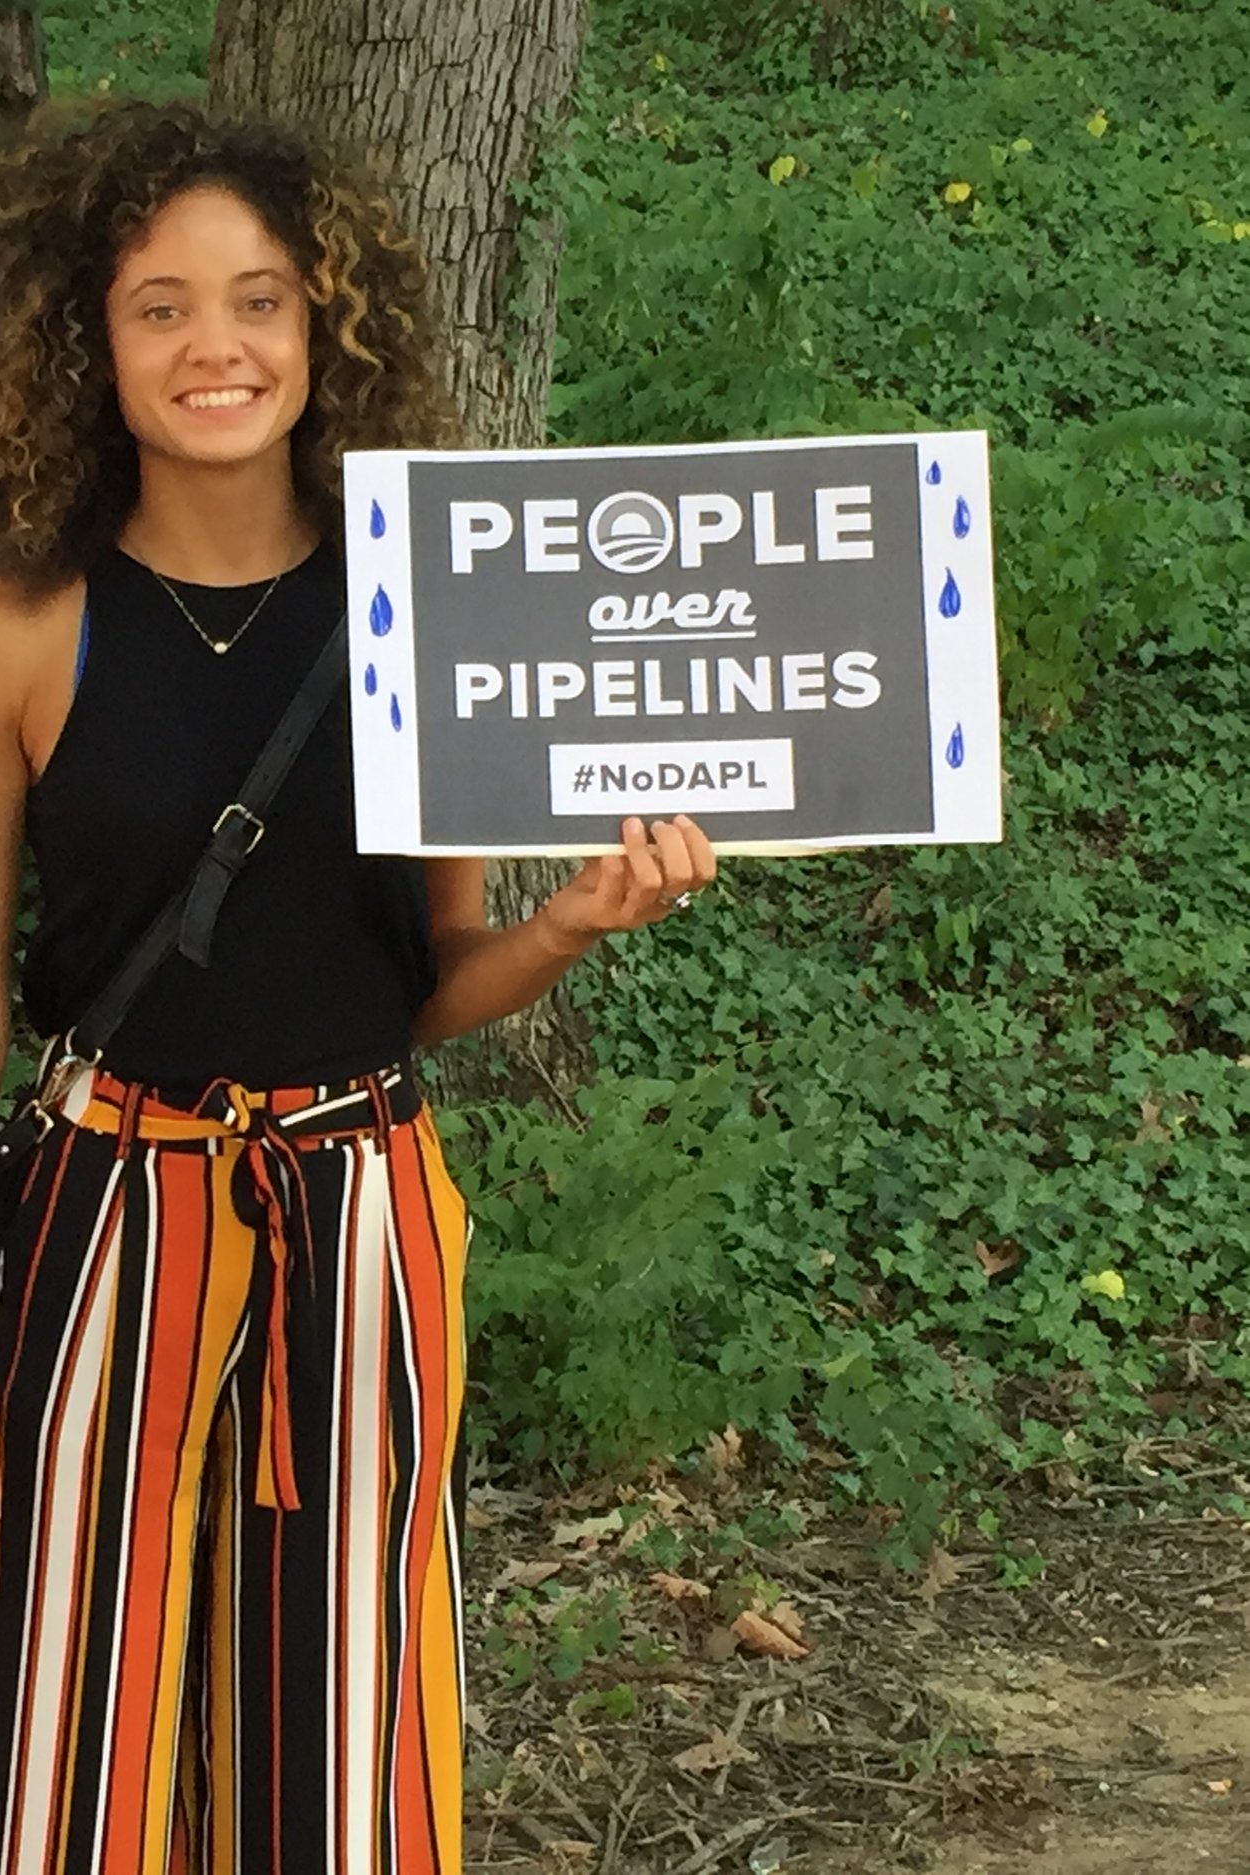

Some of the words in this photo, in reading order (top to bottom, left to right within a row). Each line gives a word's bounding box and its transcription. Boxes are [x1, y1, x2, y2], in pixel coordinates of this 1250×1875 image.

[449, 485, 875, 575] PEOPLE
[587, 588, 757, 631] over
[454, 650, 883, 719] PIPELINES
[571, 760, 768, 793] #NoDAPL
